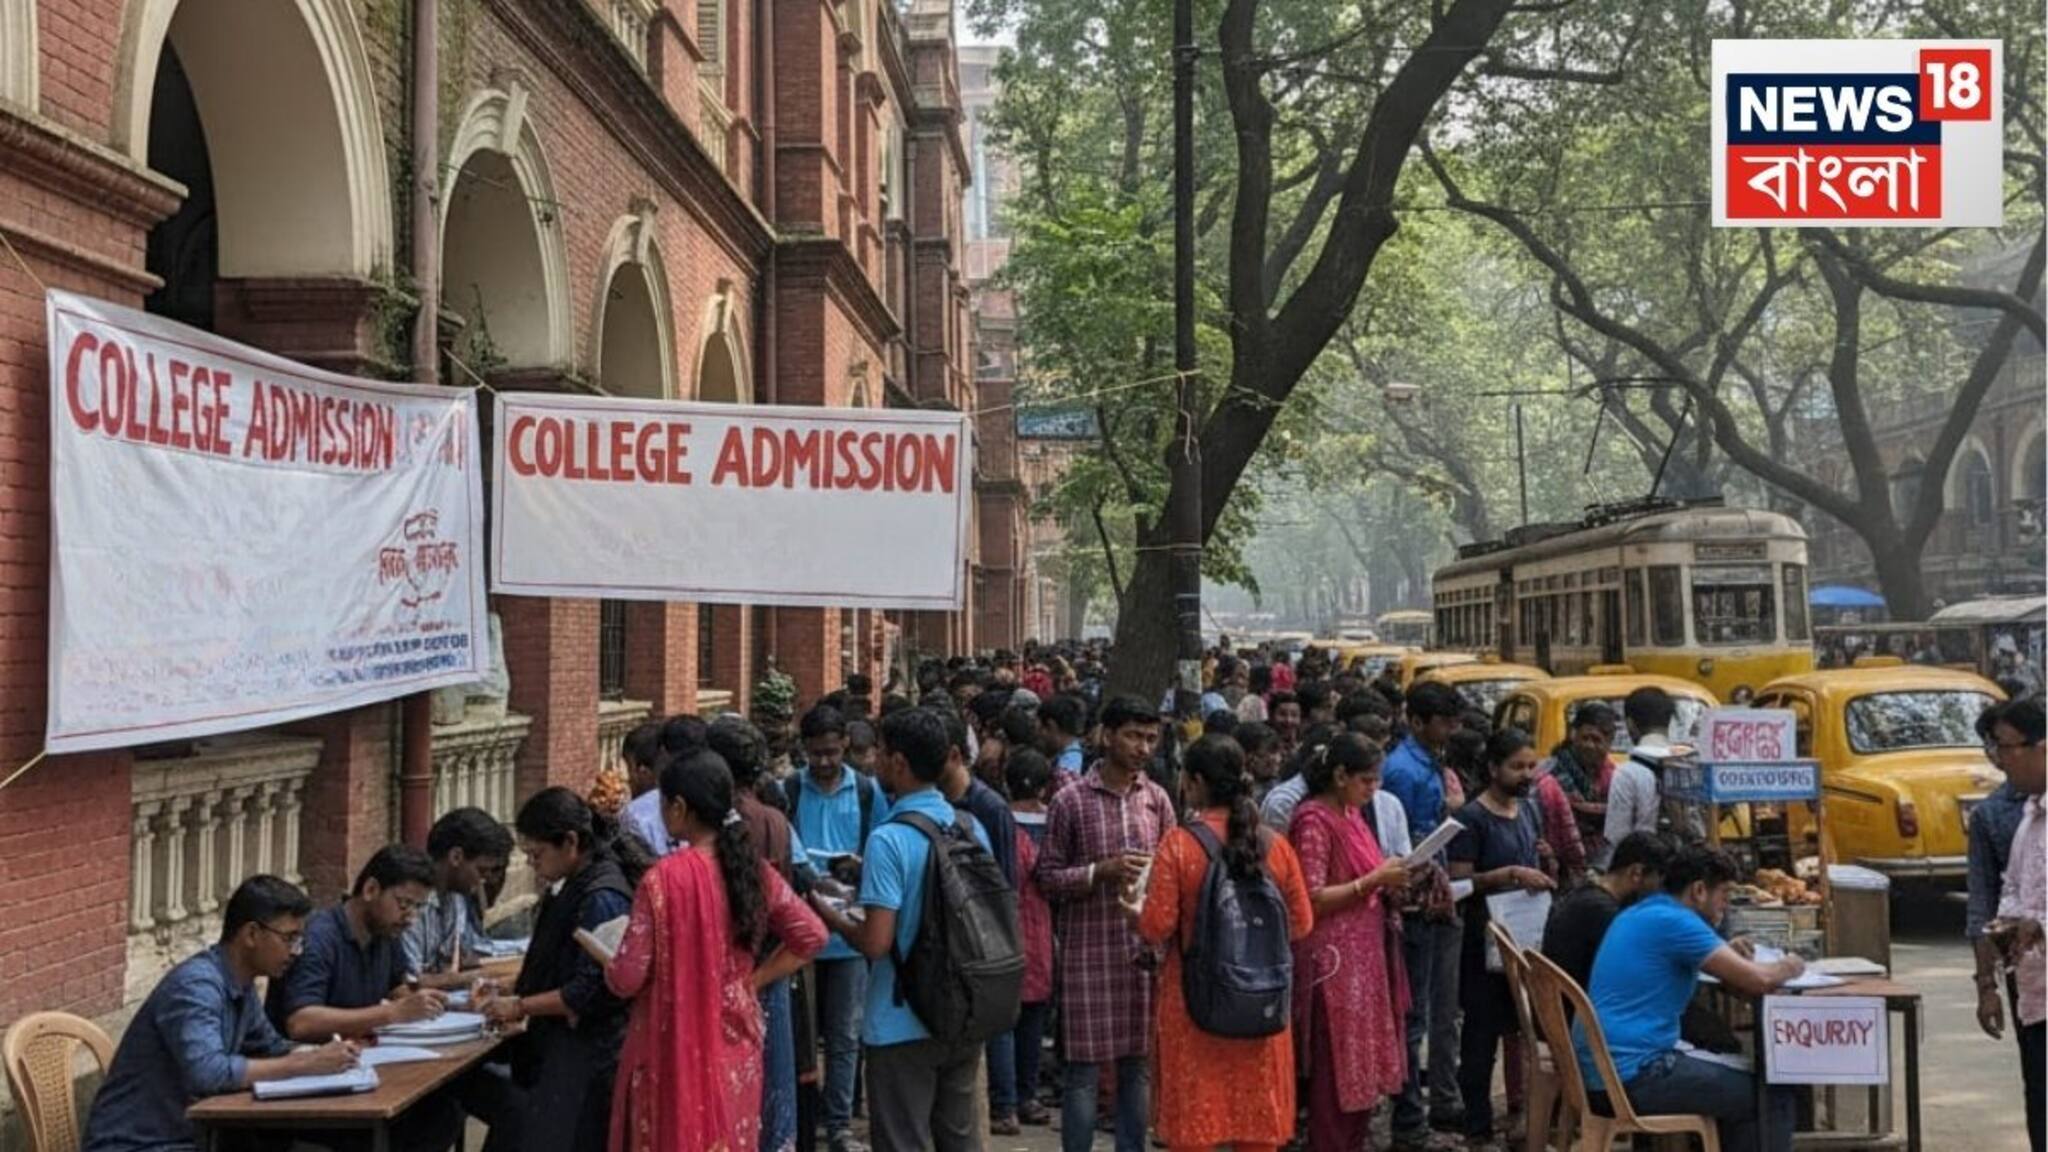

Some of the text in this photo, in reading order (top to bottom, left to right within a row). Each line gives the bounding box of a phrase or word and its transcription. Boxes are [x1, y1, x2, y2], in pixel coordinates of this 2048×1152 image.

[66, 332, 231, 455] COLLEGE
[244, 381, 394, 470] ADMISSION
[508, 415, 692, 485] COLLEGE
[711, 426, 956, 493] ADMISSION
